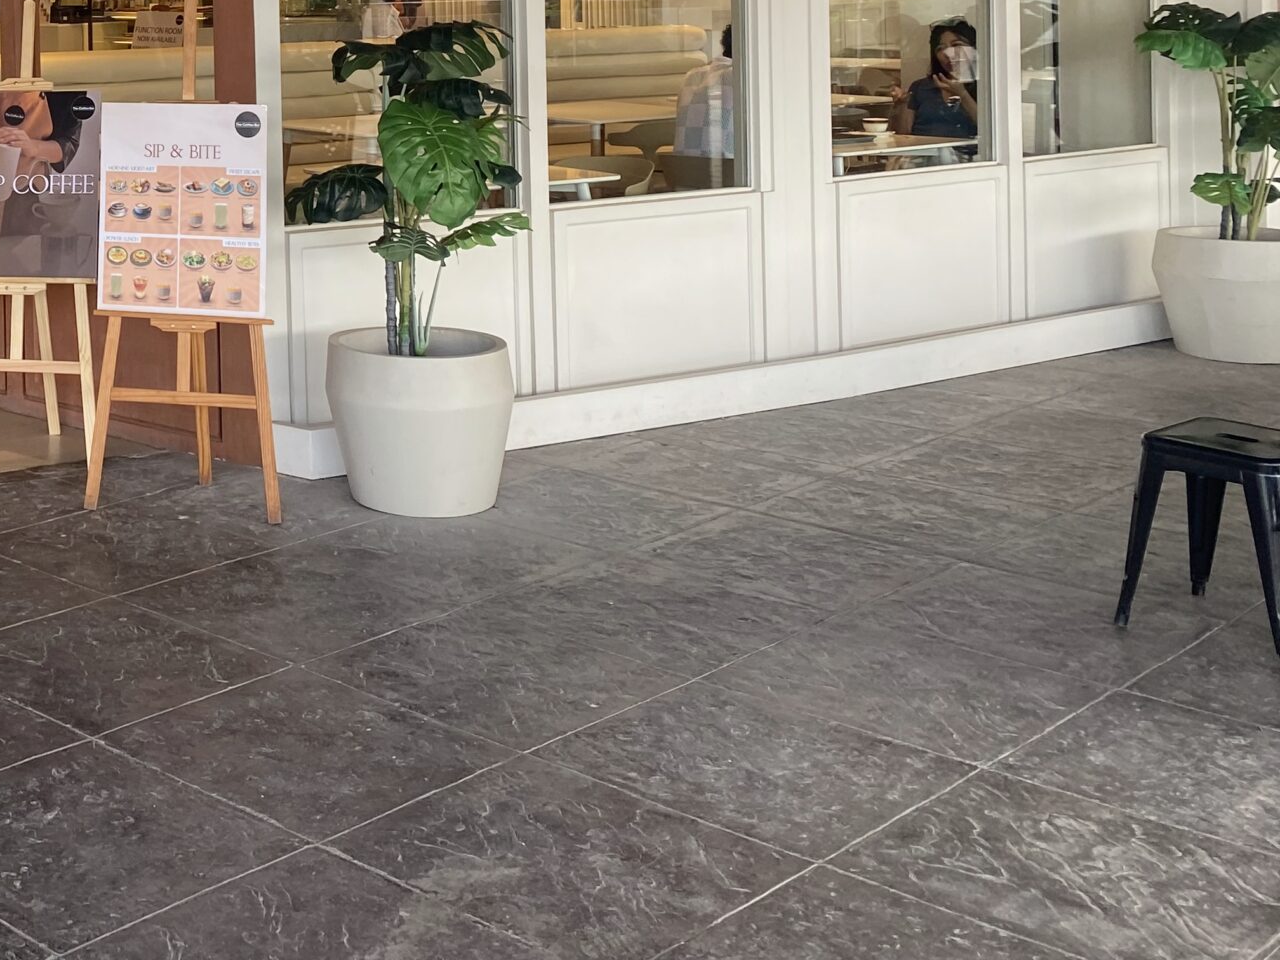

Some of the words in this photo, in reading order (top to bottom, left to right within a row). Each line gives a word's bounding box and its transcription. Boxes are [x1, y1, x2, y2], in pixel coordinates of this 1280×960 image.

[143, 143, 165, 158] SIP
[170, 144, 184, 159] &
[189, 144, 222, 159] BITE
[12, 174, 95, 195] COFFEE
